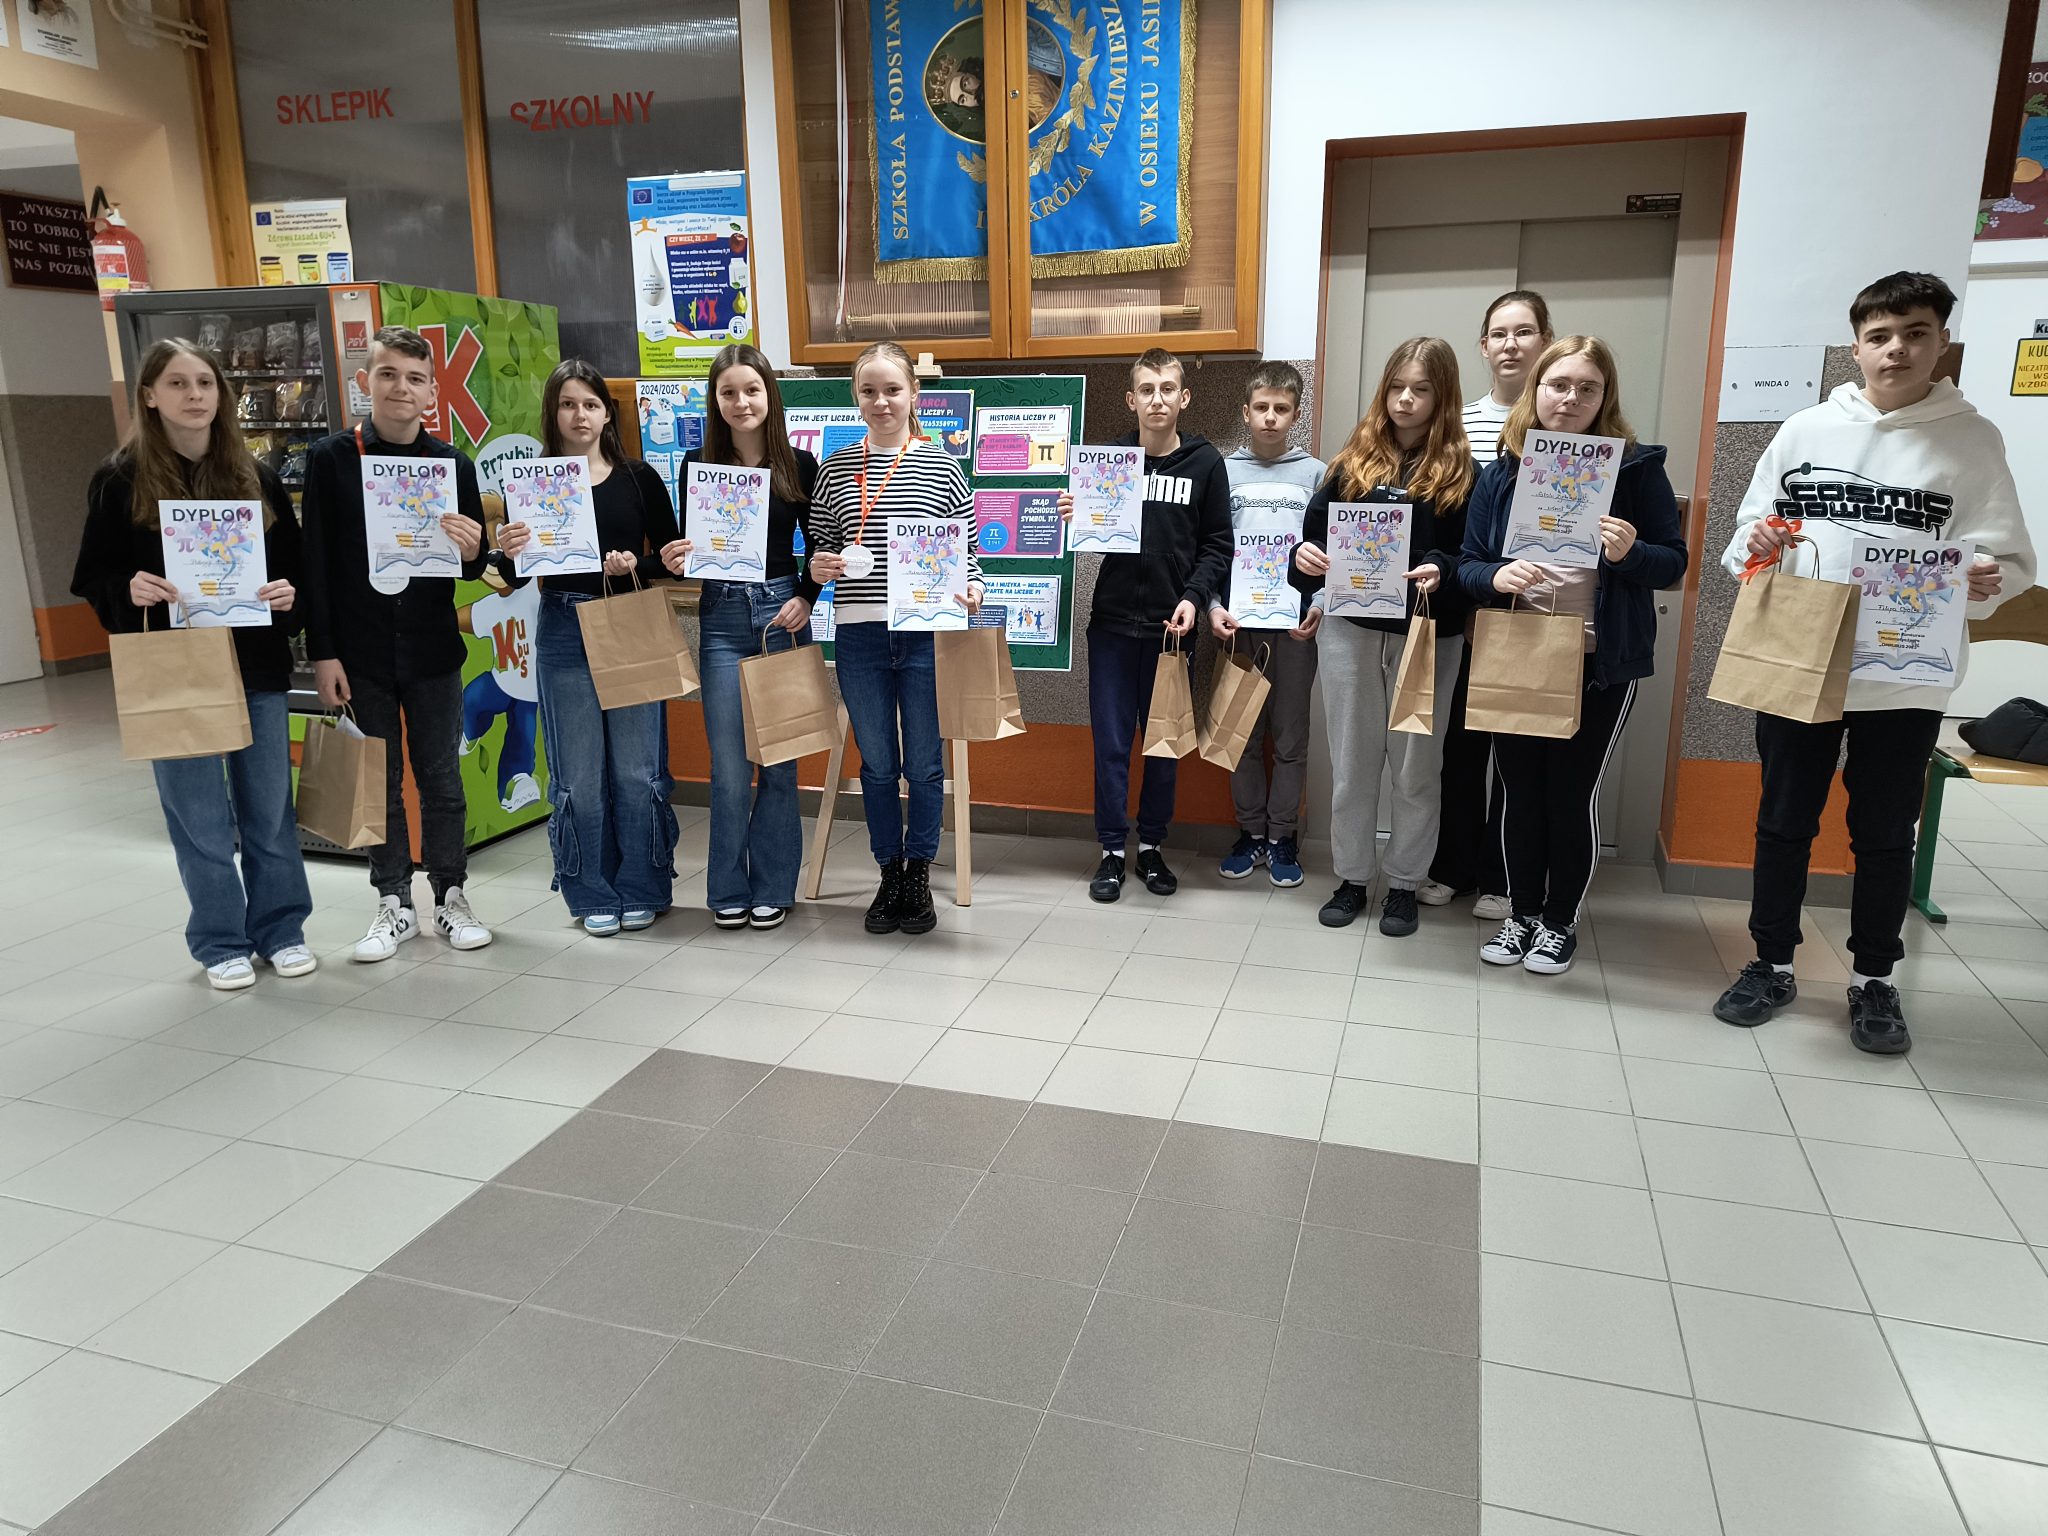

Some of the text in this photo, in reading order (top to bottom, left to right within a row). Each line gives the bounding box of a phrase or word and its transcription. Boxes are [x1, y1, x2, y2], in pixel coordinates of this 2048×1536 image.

[276, 87, 394, 124] SKLEPIK
[510, 90, 655, 132] SZKOLNY
[1030, 164, 1094, 222] KRÓLA
[1088, 0, 1128, 159] KAZIMIERZ
[1140, 82, 1160, 188] OSIEKU
[890, 132, 909, 240] SZKOŁA
[1140, 201, 1158, 228] W
[8, 220, 82, 240] TO DOBRO,
[8, 238, 34, 252] NIC
[39, 242, 62, 256] NIE
[14, 258, 42, 270] NAS
[640, 384, 680, 395] 2024/2025
[790, 414, 810, 422] CZYM
[812, 414, 829, 422] JEST
[830, 414, 856, 422] LICZBA
[922, 408, 946, 416] LICZBY
[946, 408, 954, 416] PI
[990, 414, 1020, 422] HISTORIA
[1534, 438, 1613, 460] DYPLOM
[1078, 452, 1136, 464] DYPLOM
[372, 464, 446, 479] DYPLOM
[512, 463, 580, 479] DYPLOM
[697, 470, 761, 488] DYPLOM
[1032, 498, 1050, 506] SKĄD
[172, 508, 252, 522] DYPLOM
[1337, 509, 1403, 524] DYPLOM
[896, 524, 960, 538] DYPLOM
[1240, 535, 1296, 546] DYPLOM
[1864, 547, 1960, 566] DYPLOM
